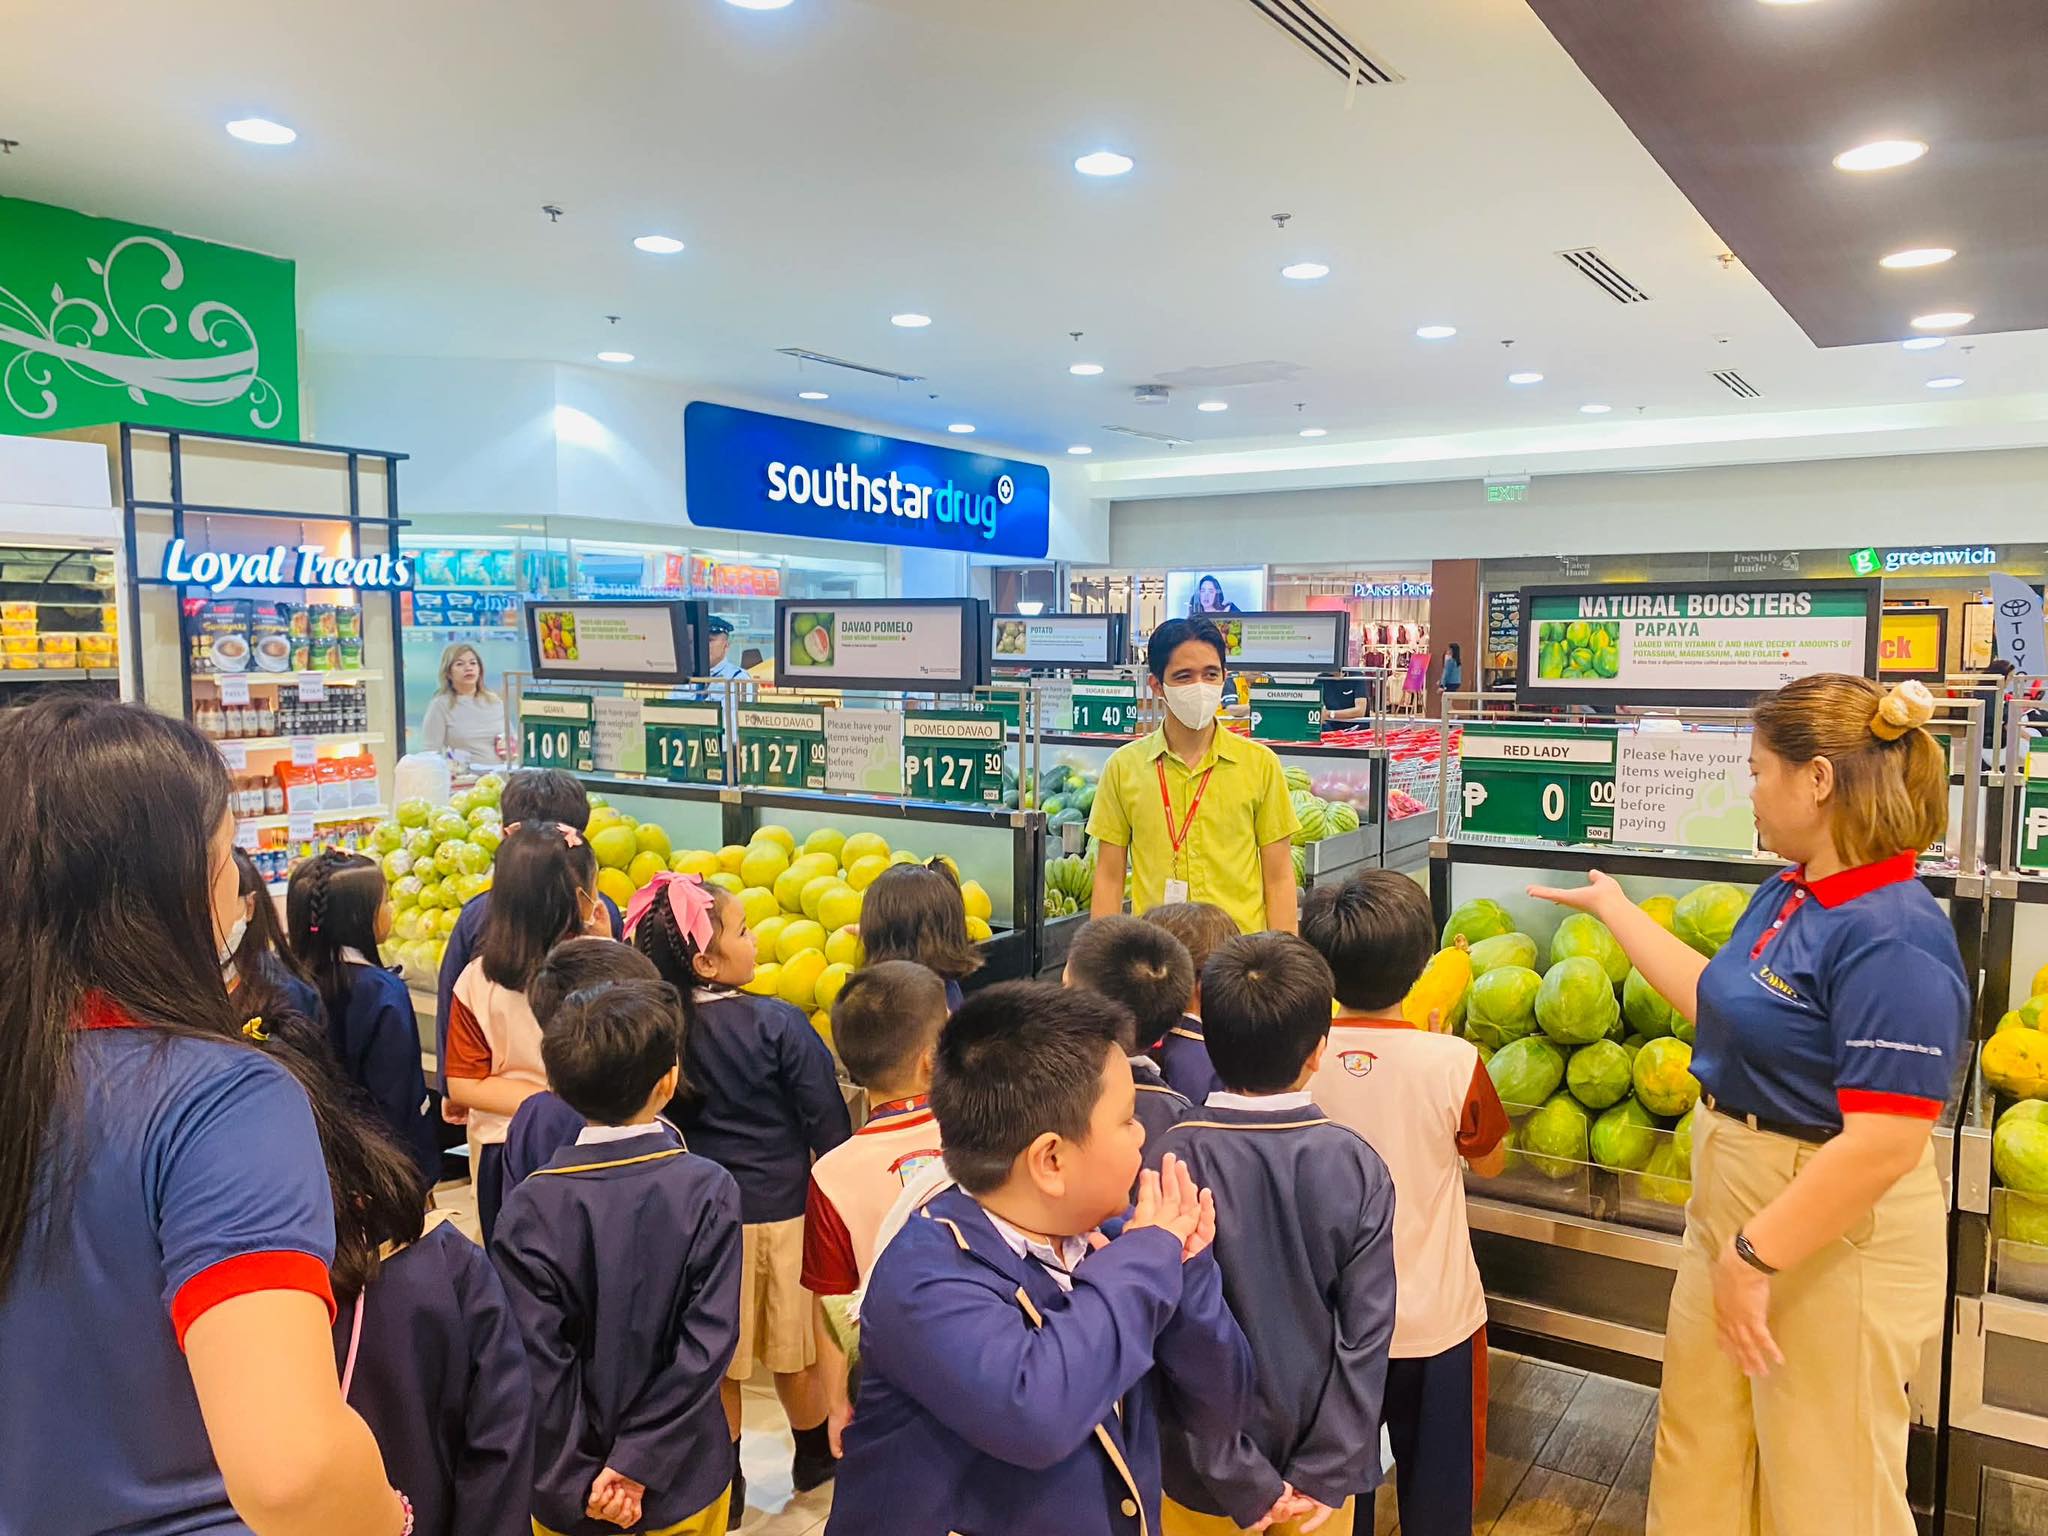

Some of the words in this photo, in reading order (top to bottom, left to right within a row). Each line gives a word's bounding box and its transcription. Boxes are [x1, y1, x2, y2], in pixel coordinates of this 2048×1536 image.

[1487, 484, 1526, 502] EXIT
[1885, 547, 1996, 571] greenwich
[165, 538, 287, 594] Loyal
[297, 544, 410, 587] Treats
[1733, 564, 1767, 573] made
[1578, 594, 1680, 617] NATURAL
[1687, 592, 1812, 617] BOOSTERS
[841, 621, 871, 633] DAVAO
[874, 621, 913, 633] POMELO
[1030, 626, 1053, 634] POTATO
[1635, 622, 1700, 637] PAPAYA
[1799, 640, 1839, 648] AMOUNTS
[1734, 650, 1751, 658] AND
[1753, 650, 1780, 658] FOLATE
[1267, 691, 1303, 699] CHAMPION
[544, 705, 565, 714] GUAVA
[745, 714, 782, 727] POMELO
[783, 717, 814, 728] DAVAO
[1308, 711, 1320, 722] 00
[827, 720, 851, 730] Please
[853, 720, 873, 731] have
[874, 725, 892, 733] your
[913, 724, 955, 736] POMELO
[957, 725, 993, 737] DAVAO
[527, 730, 569, 760] 100
[851, 735, 884, 746] weighed
[658, 737, 699, 768] 127
[811, 743, 825, 760] 00
[827, 745, 840, 754] for
[841, 746, 869, 757] pricing
[1503, 745, 1530, 757] RED
[1533, 746, 1570, 758] LADY
[1623, 748, 1666, 761] Please
[1670, 749, 1704, 762] have
[1706, 753, 1743, 765] your
[828, 757, 854, 767] before
[984, 753, 1001, 771] 50
[829, 771, 855, 781] paying
[1622, 765, 1660, 778] items
[1663, 766, 1726, 783] weighed
[1621, 782, 1640, 794] for
[1645, 783, 1695, 799] pricing
[1542, 783, 1565, 822] 0
[1590, 780, 1615, 803] 00
[1620, 799, 1666, 812] before
[1619, 818, 1666, 832] paying
